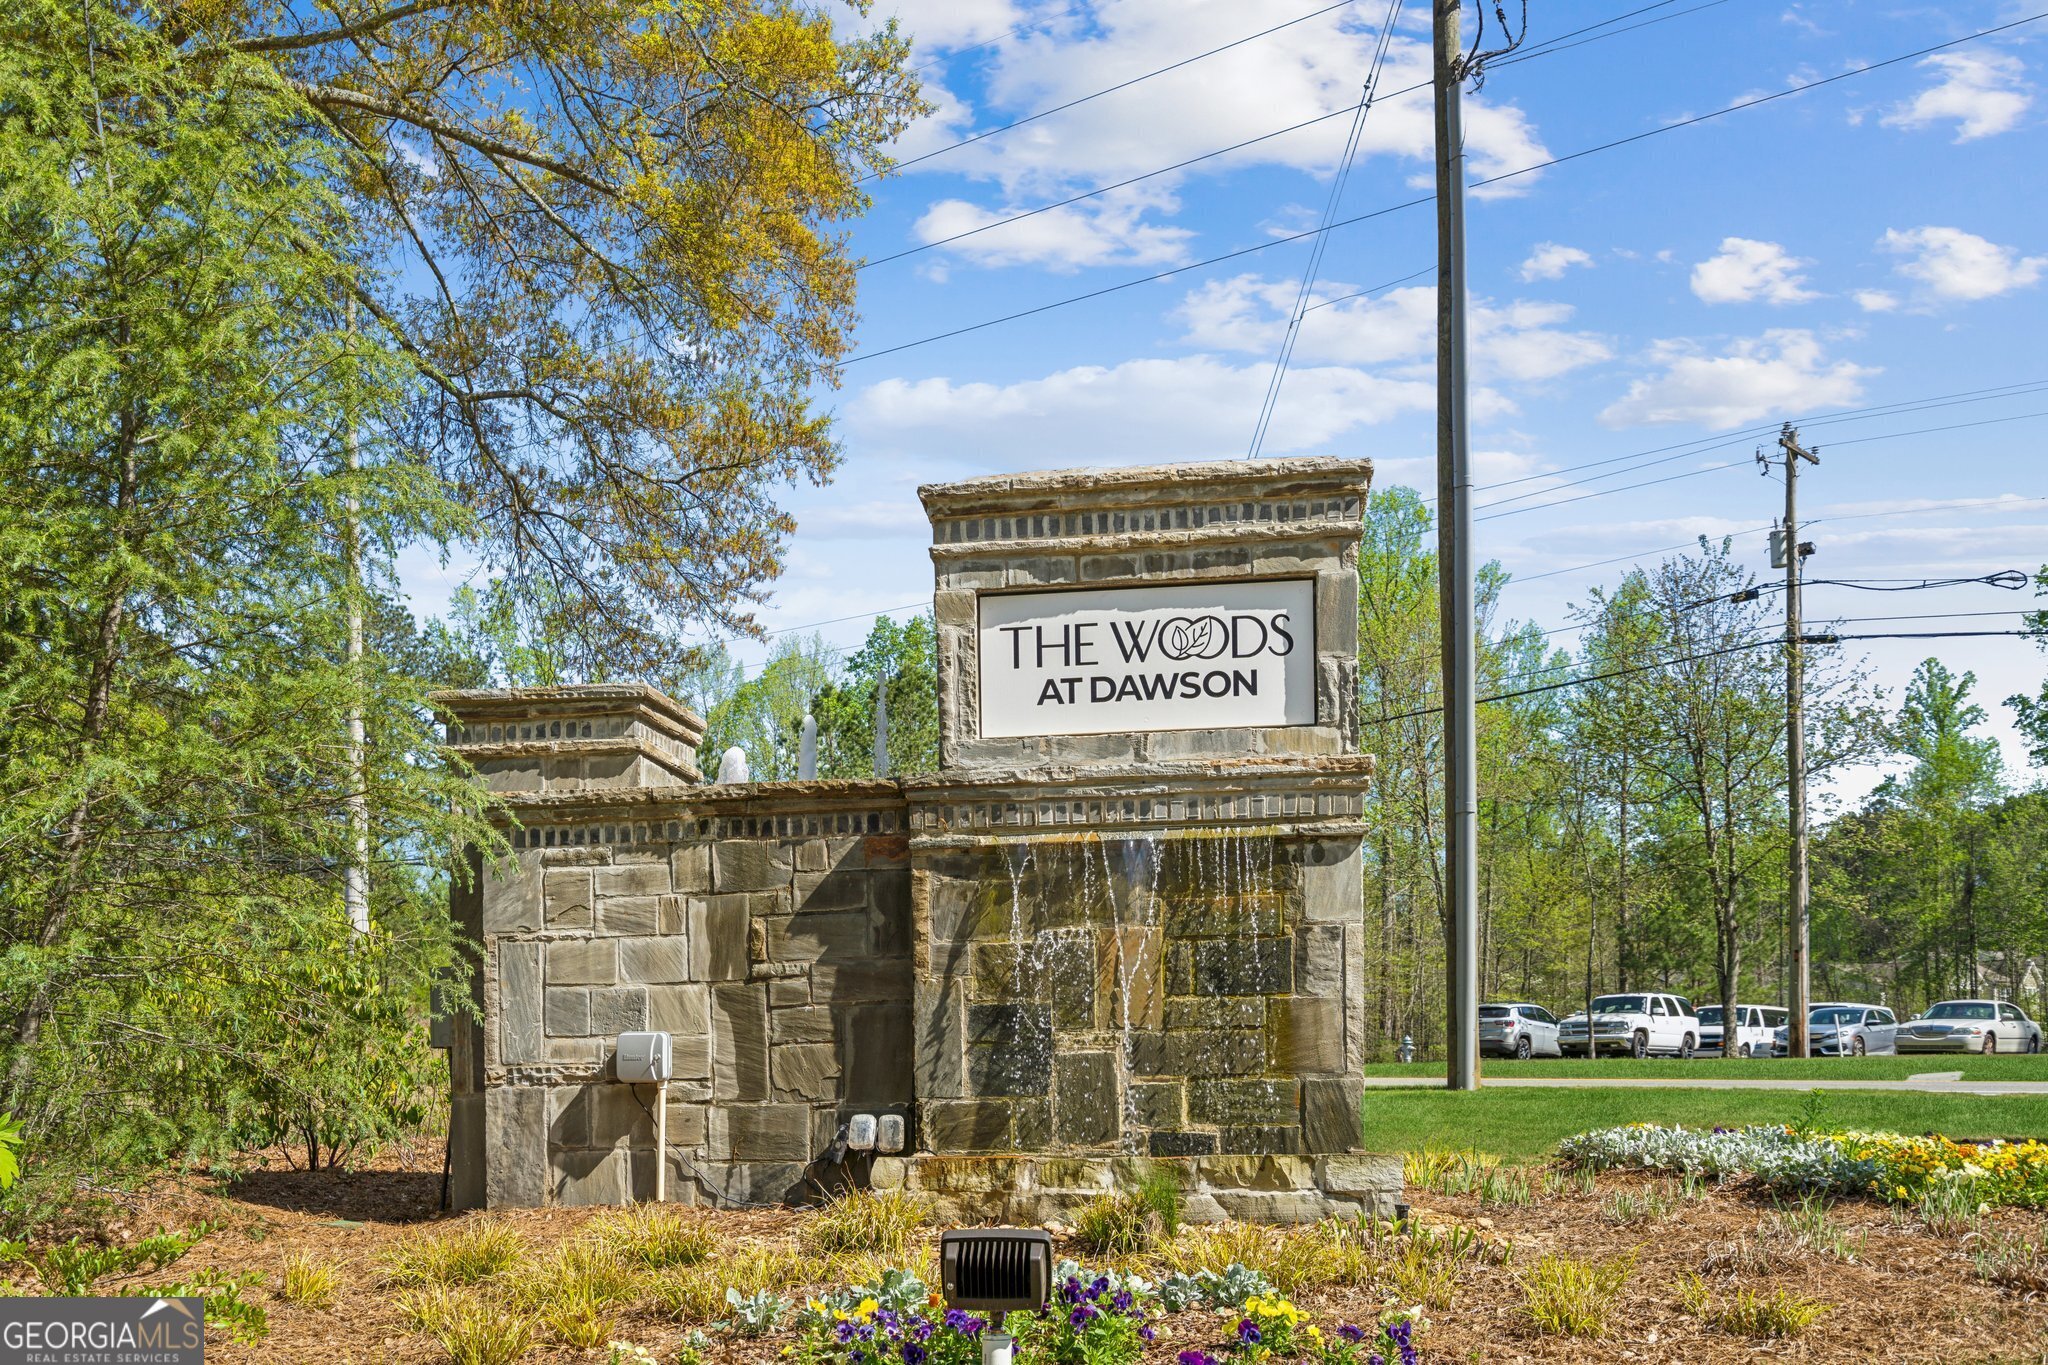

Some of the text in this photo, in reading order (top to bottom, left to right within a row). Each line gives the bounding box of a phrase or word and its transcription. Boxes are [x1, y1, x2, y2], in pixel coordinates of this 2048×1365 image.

[1000, 613, 1295, 669] THE WOODS
[1037, 669, 1258, 706] AT DAWSON
